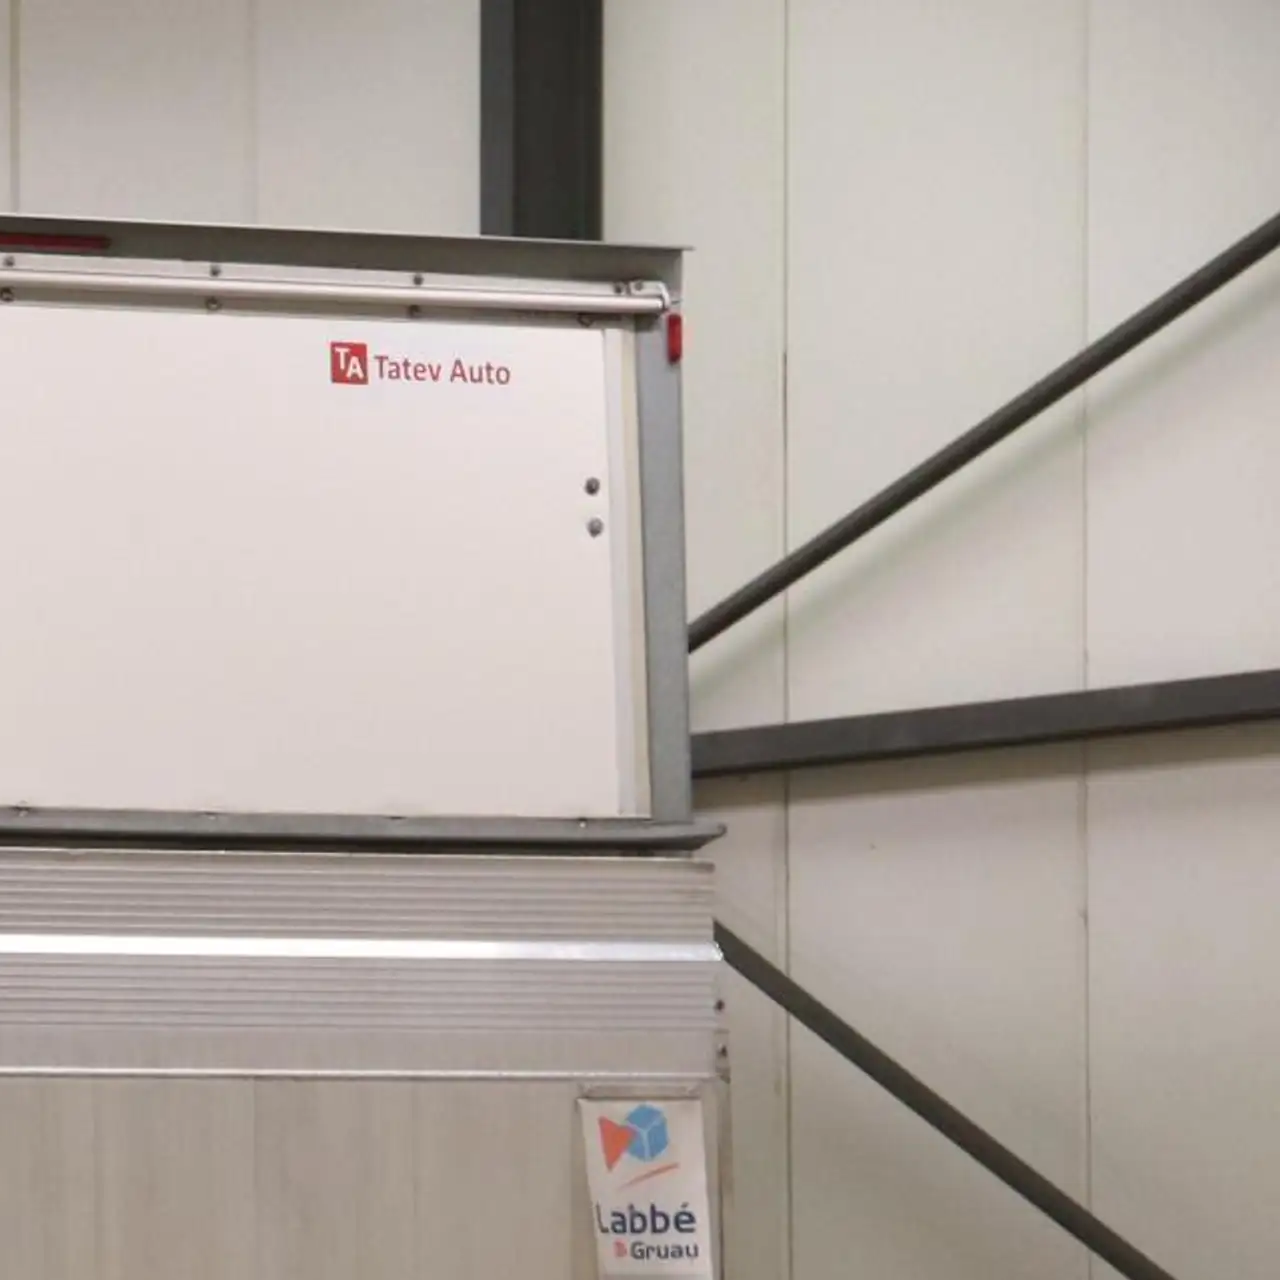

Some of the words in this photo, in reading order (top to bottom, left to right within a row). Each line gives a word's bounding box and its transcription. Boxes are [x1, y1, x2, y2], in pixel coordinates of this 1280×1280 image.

[333, 346, 365, 380] TA
[373, 355, 441, 383] Tatev
[450, 358, 511, 385] Auto
[595, 1201, 697, 1235] Labbé
[630, 1241, 699, 1260] Gruau
